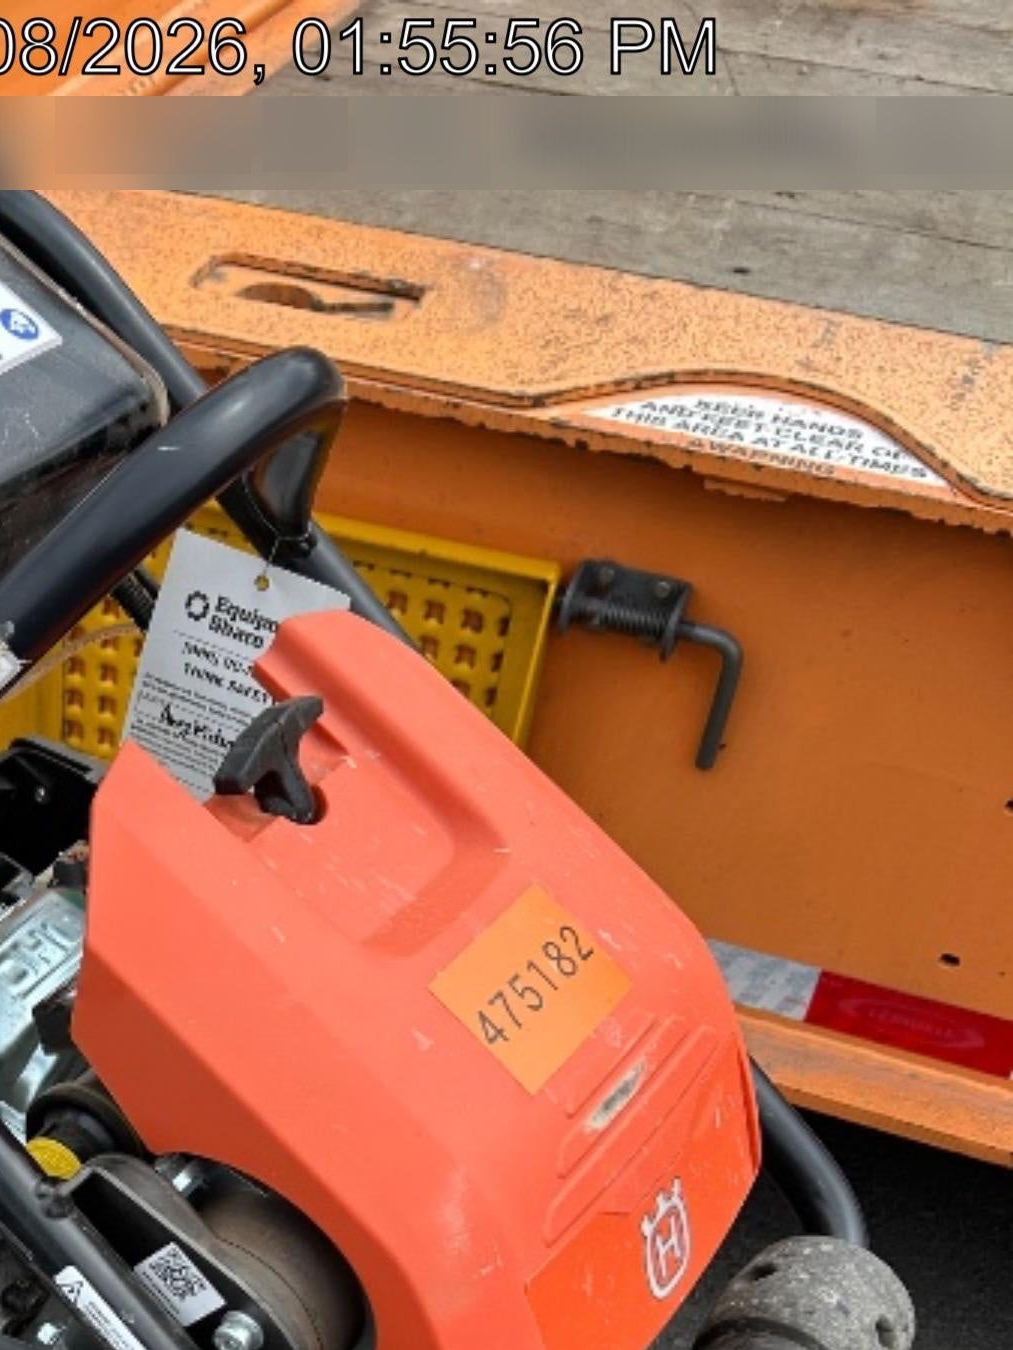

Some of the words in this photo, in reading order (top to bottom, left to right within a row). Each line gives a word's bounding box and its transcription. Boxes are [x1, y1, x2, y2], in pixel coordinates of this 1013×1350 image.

[675, 419, 745, 442] AREA
[771, 412, 864, 440] HANDS
[775, 425, 865, 453] CLEAR
[476, 925, 594, 1046] 475182
